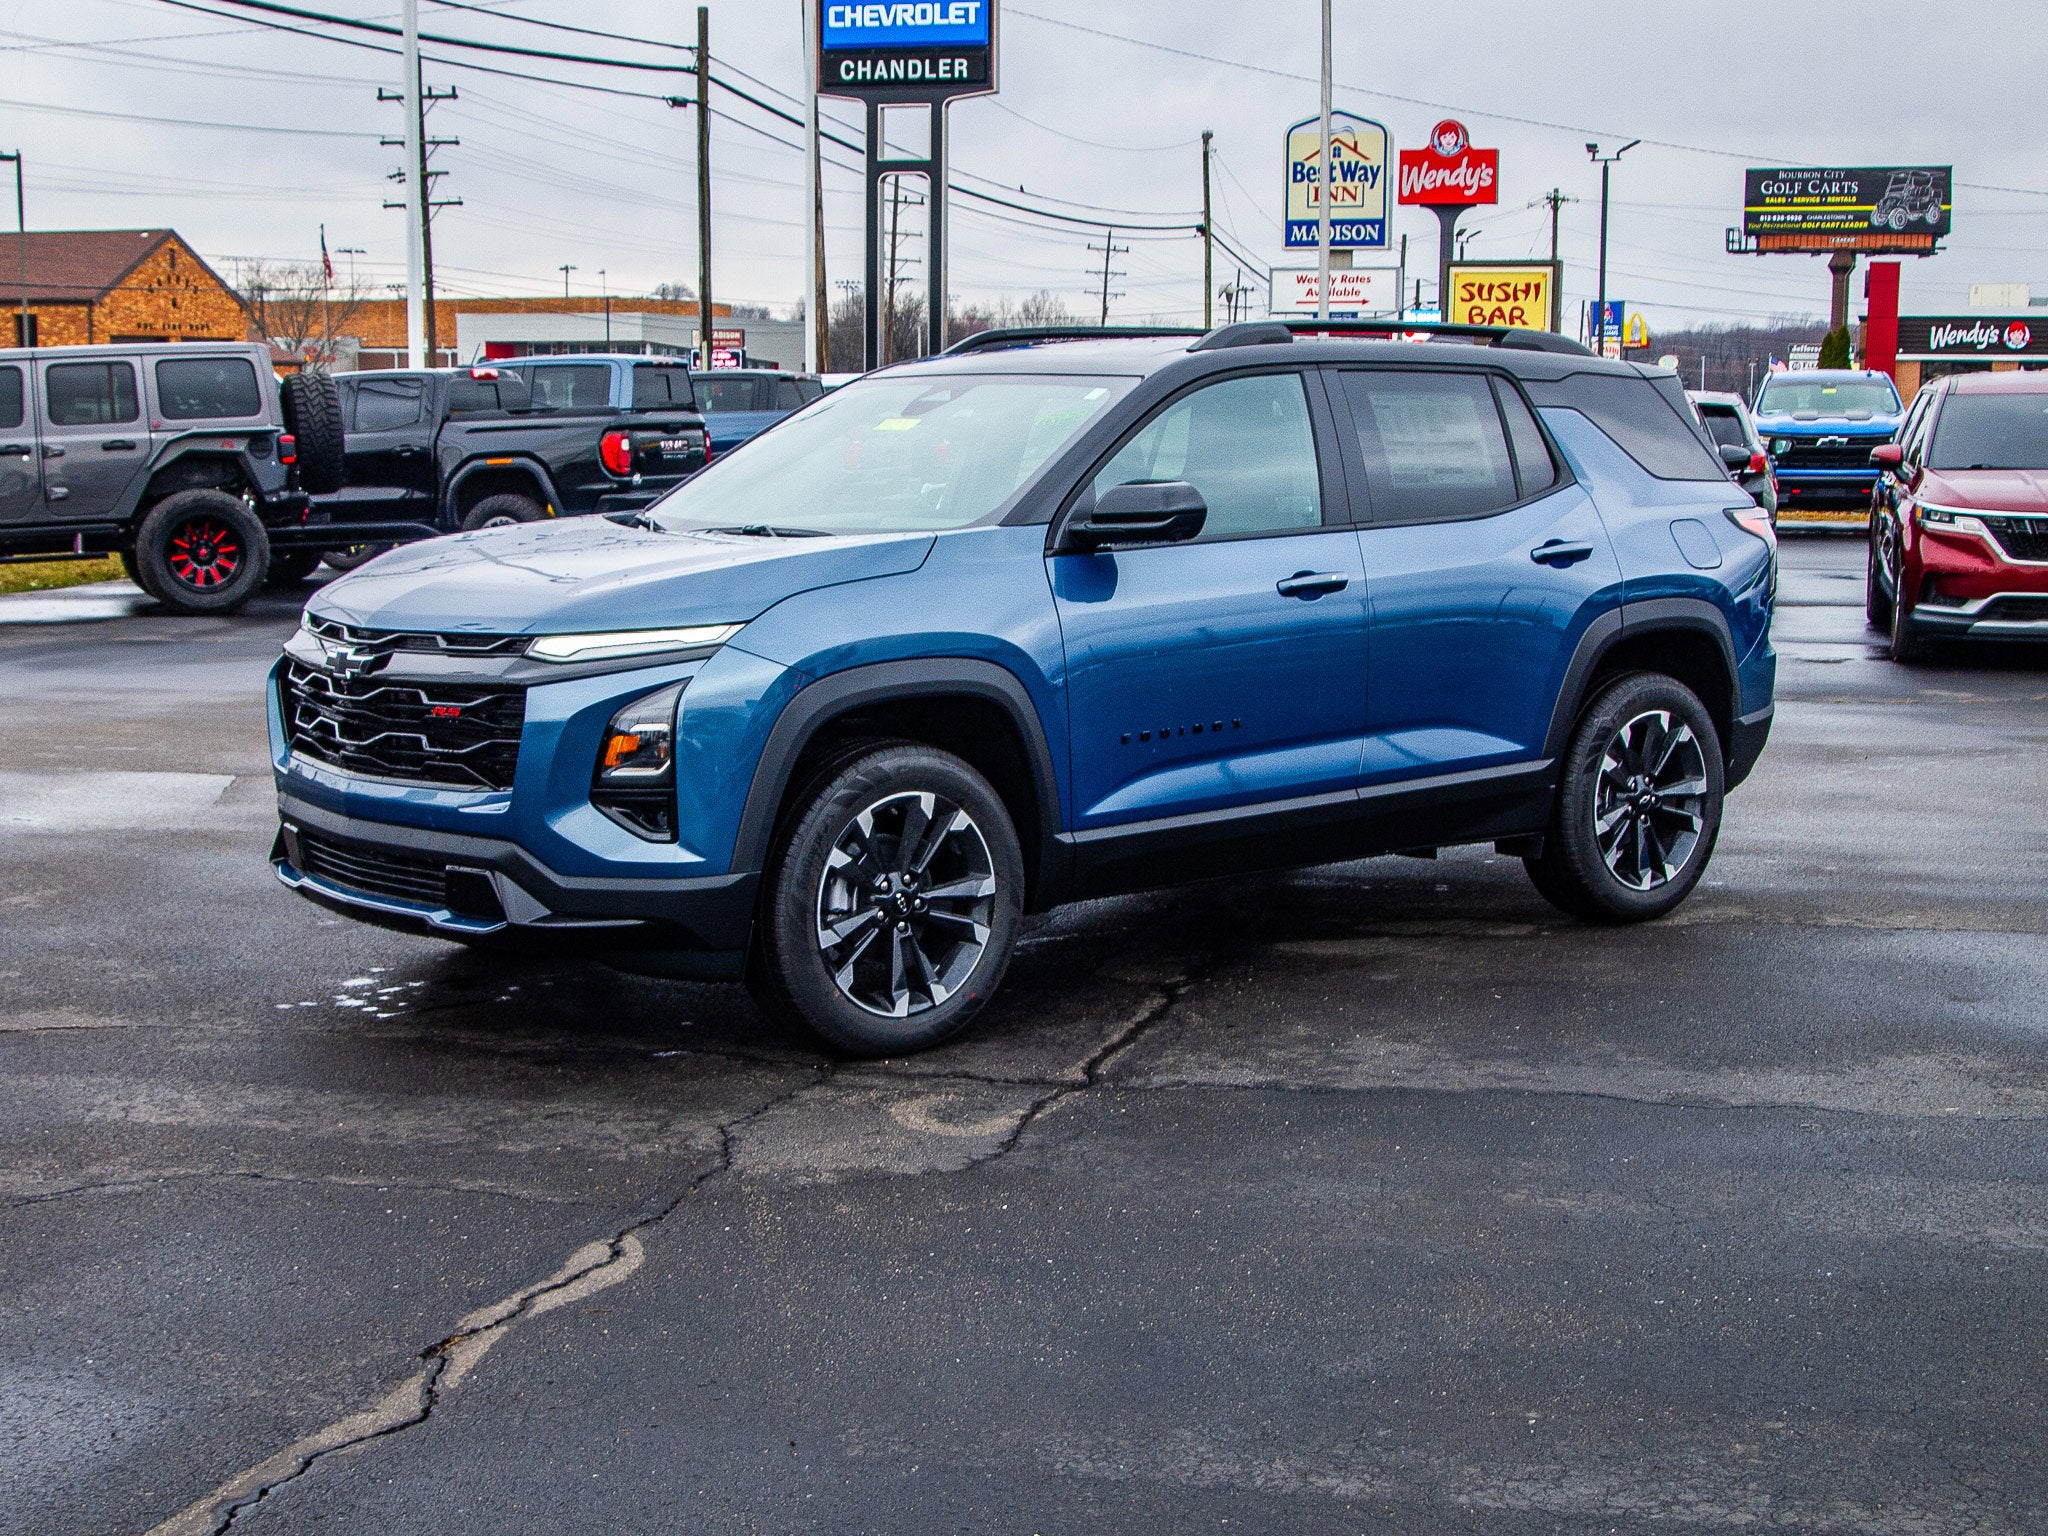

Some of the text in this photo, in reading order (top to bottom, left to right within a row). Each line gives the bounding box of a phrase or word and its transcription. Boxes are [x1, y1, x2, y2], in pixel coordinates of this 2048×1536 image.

[828, 1, 981, 29] CHEVROLET
[839, 58, 969, 82] CHANDLER
[1339, 160, 1382, 190] Way
[1401, 156, 1493, 197] Wendy's
[1823, 169, 1847, 179] CITY
[1761, 180, 1858, 194] GOLF CARTS
[1296, 274, 1372, 286] Weely Rates
[1305, 287, 1361, 297] Avilable
[1460, 281, 1542, 303] SUSHI
[1468, 304, 1529, 327] BAR
[1929, 320, 2000, 350] Wendy's
